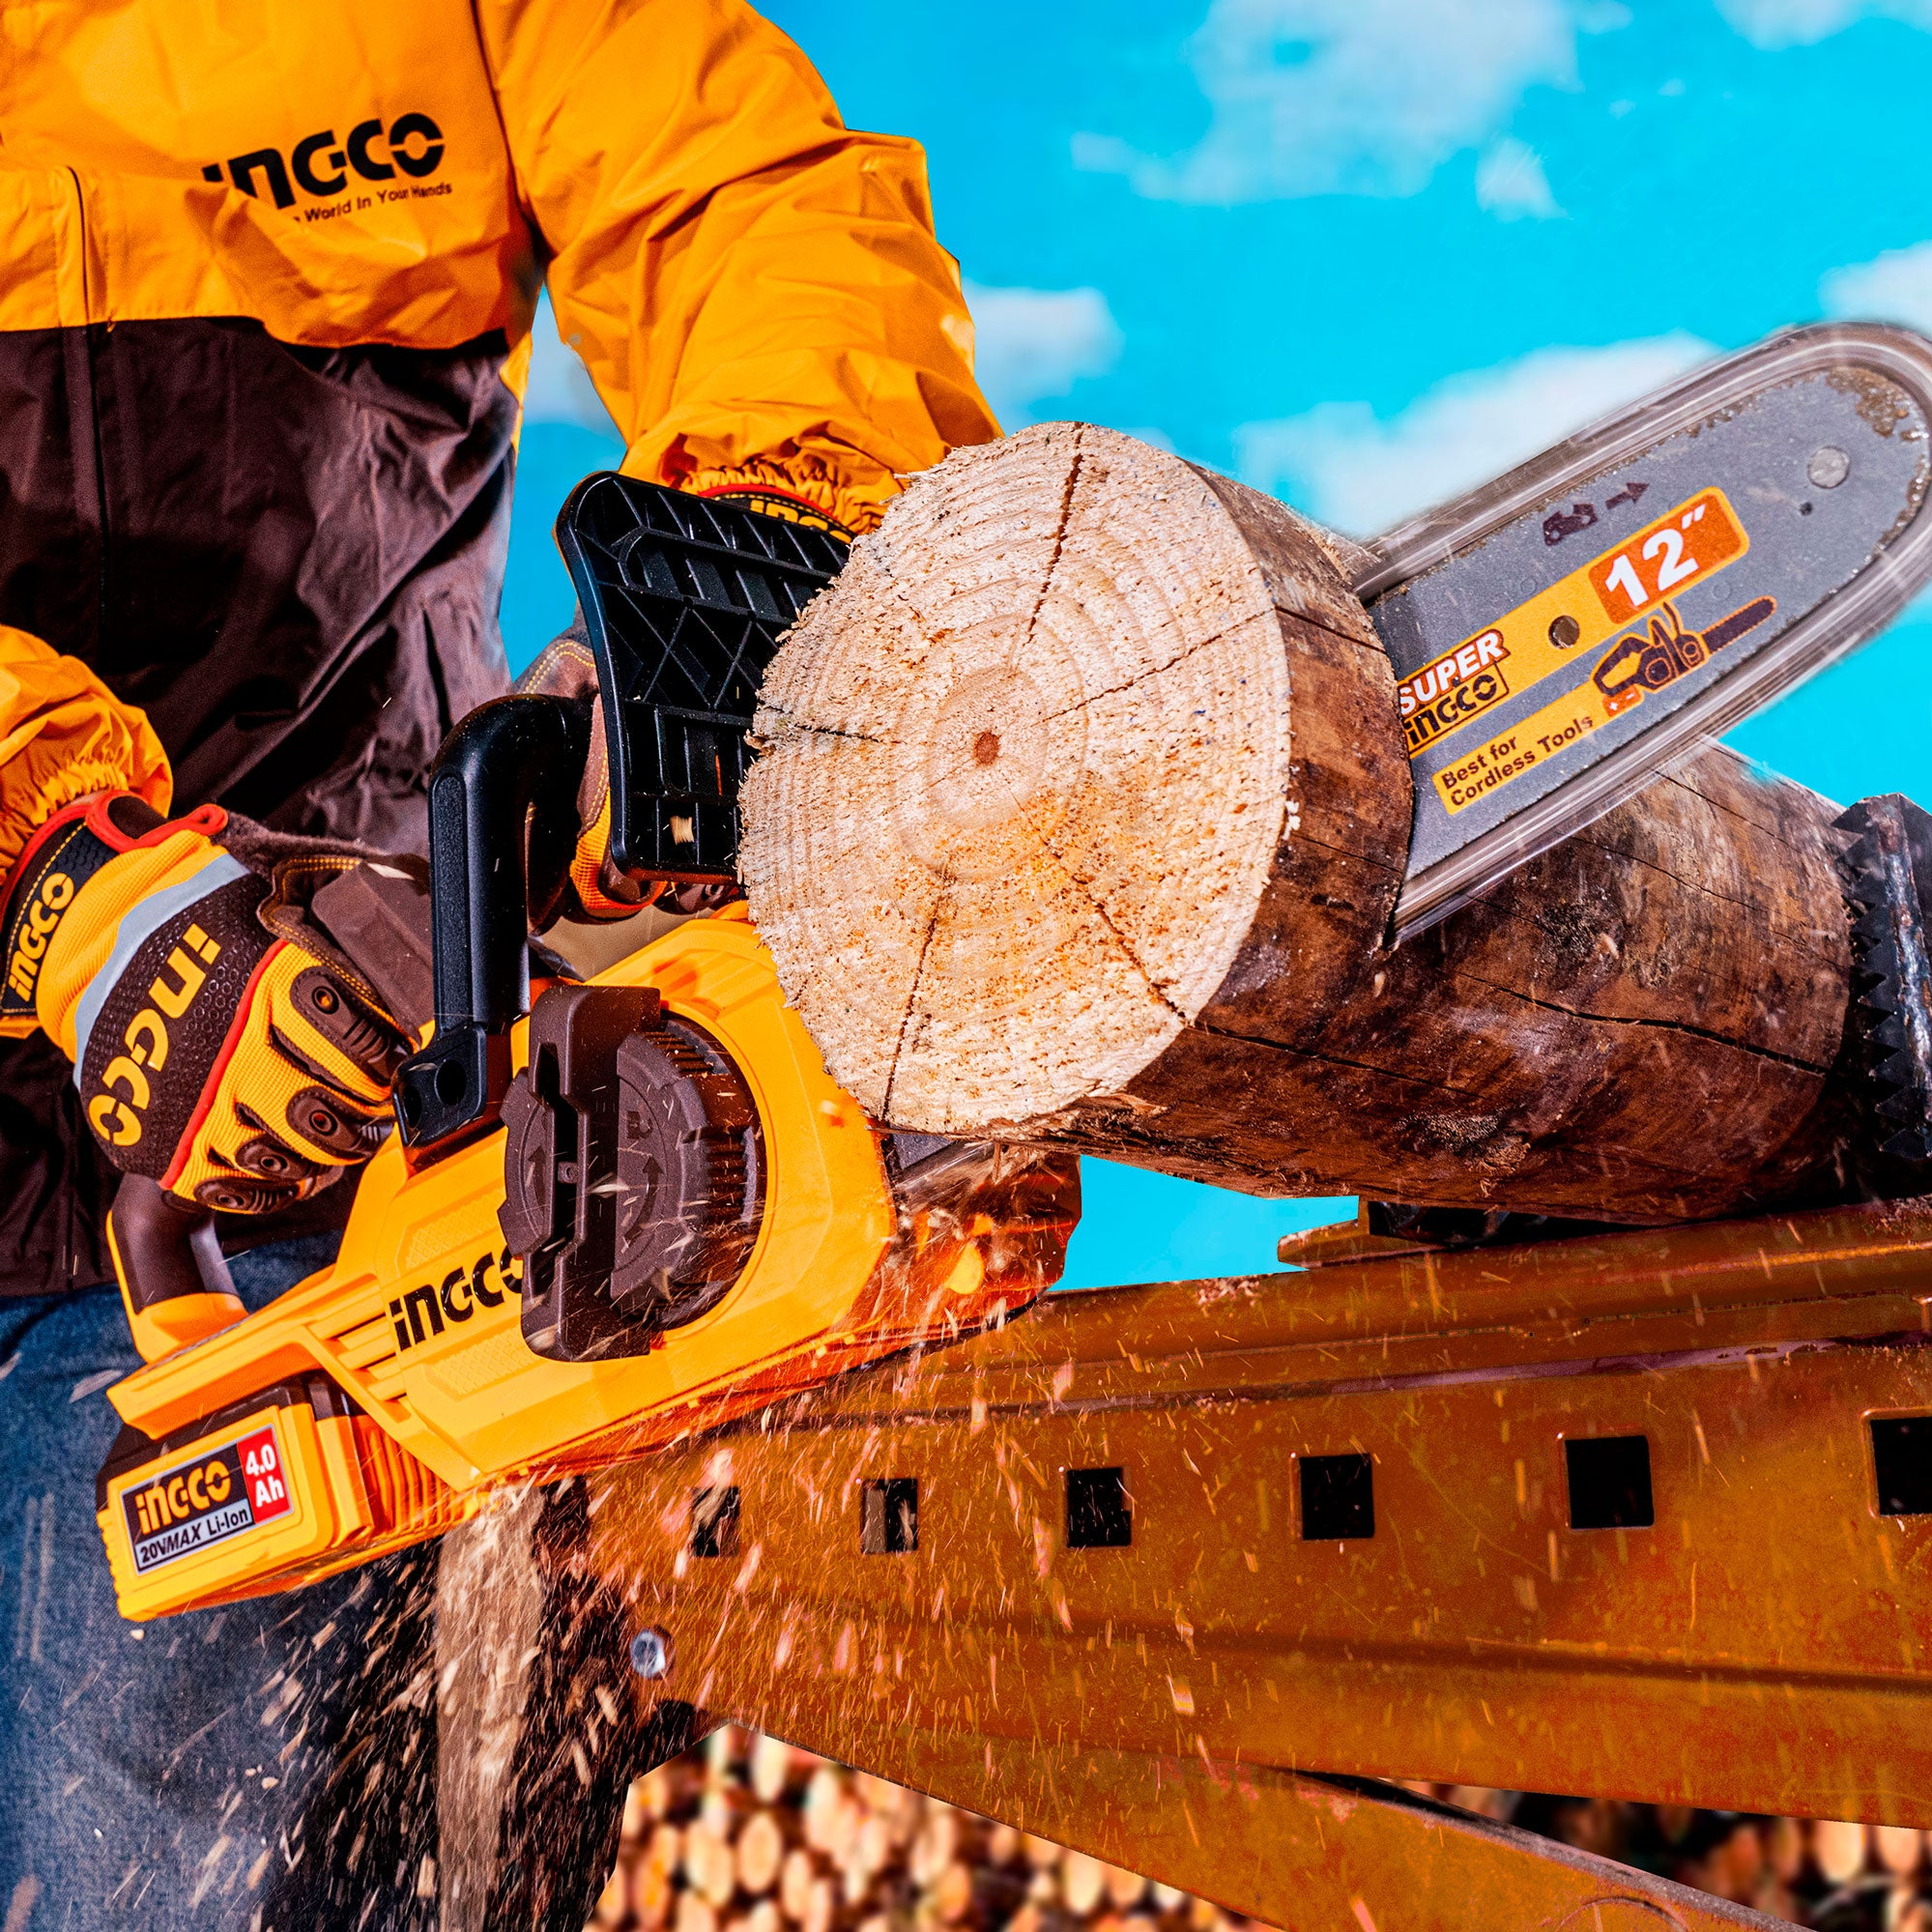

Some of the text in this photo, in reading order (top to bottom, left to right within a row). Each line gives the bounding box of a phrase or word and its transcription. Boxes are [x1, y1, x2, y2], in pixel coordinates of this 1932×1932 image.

[303, 199, 352, 222] World
[357, 196, 372, 211] In
[377, 189, 410, 204] Your
[411, 182, 452, 198] Hands
[1399, 631, 1506, 716] SUPER
[1441, 736, 1516, 790] Best for
[1451, 716, 1594, 806] Cordless Tools
[245, 1444, 277, 1477] 4.0
[255, 1475, 284, 1508] Ah
[207, 1507, 249, 1536] Li-Ion
